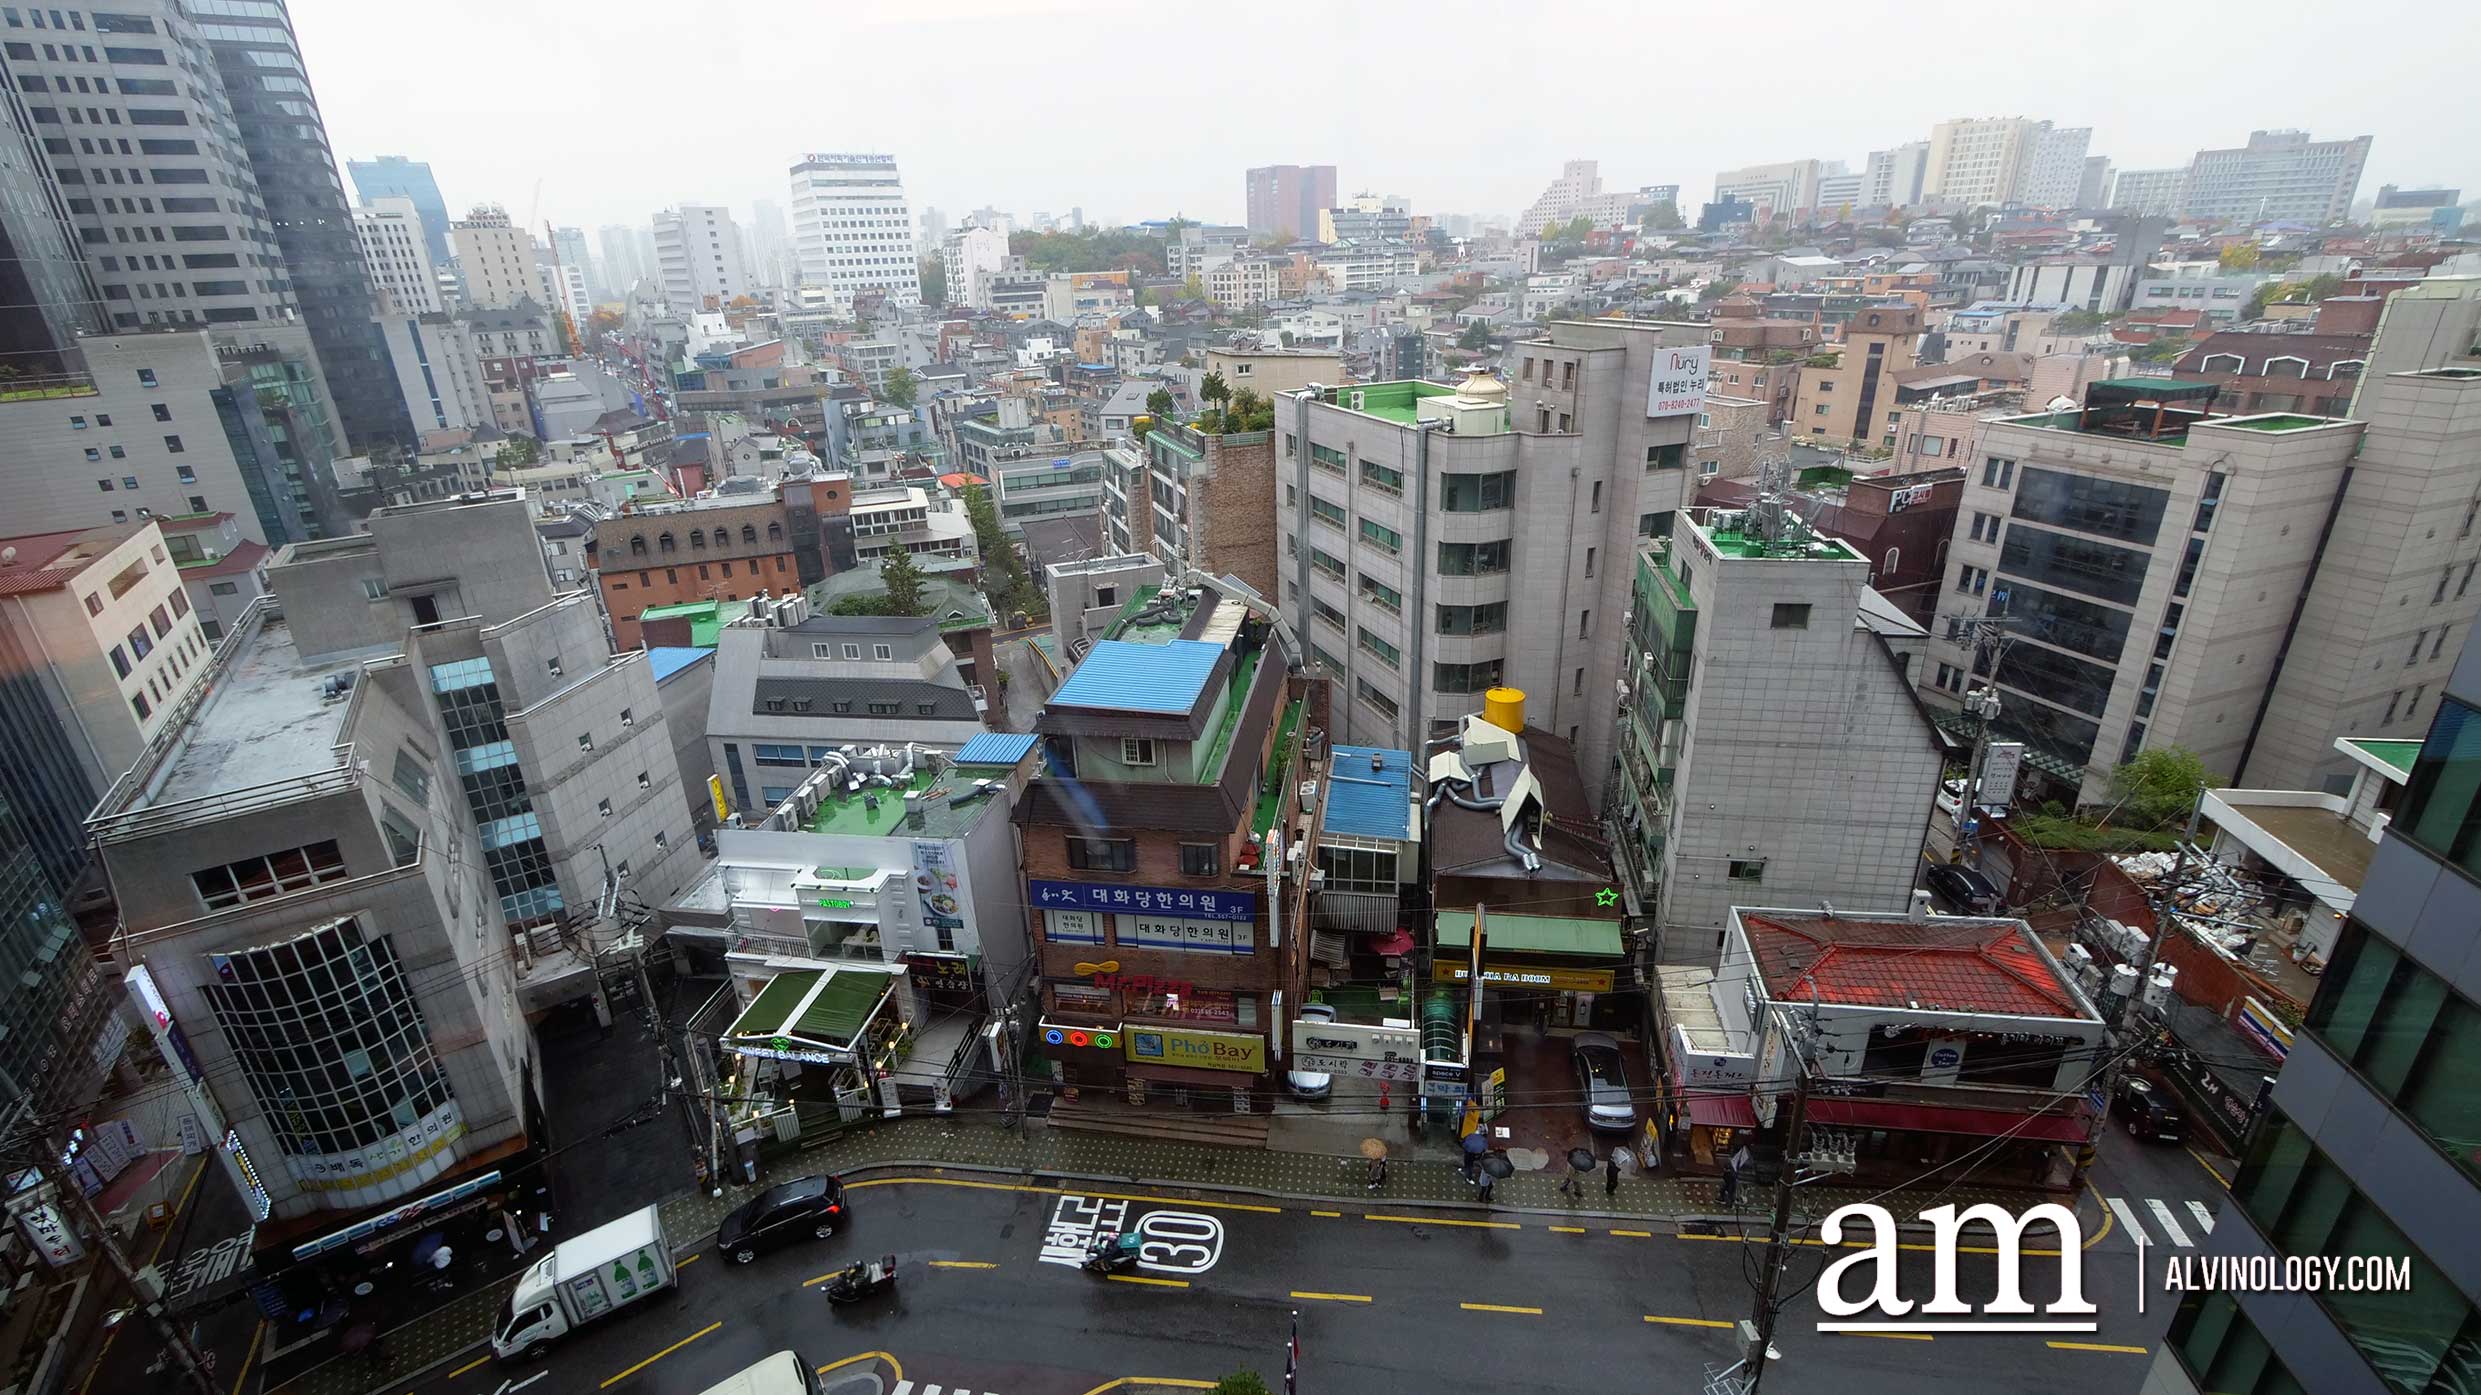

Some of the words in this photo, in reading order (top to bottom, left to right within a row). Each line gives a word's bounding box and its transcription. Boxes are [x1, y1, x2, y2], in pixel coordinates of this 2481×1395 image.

[1657, 380, 1688, 395] 특허법인
[1690, 378, 1705, 392] 누리
[1092, 889, 1217, 912] 대화당한의원
[1230, 905, 1244, 915] 3F
[1138, 922, 1229, 939] 대화당한의원
[936, 961, 966, 976] 노래
[738, 1046, 775, 1059] SWEET
[777, 1050, 831, 1064] BALANCE
[1213, 1042, 1253, 1060] Bay
[1139, 1216, 1217, 1267] 30
